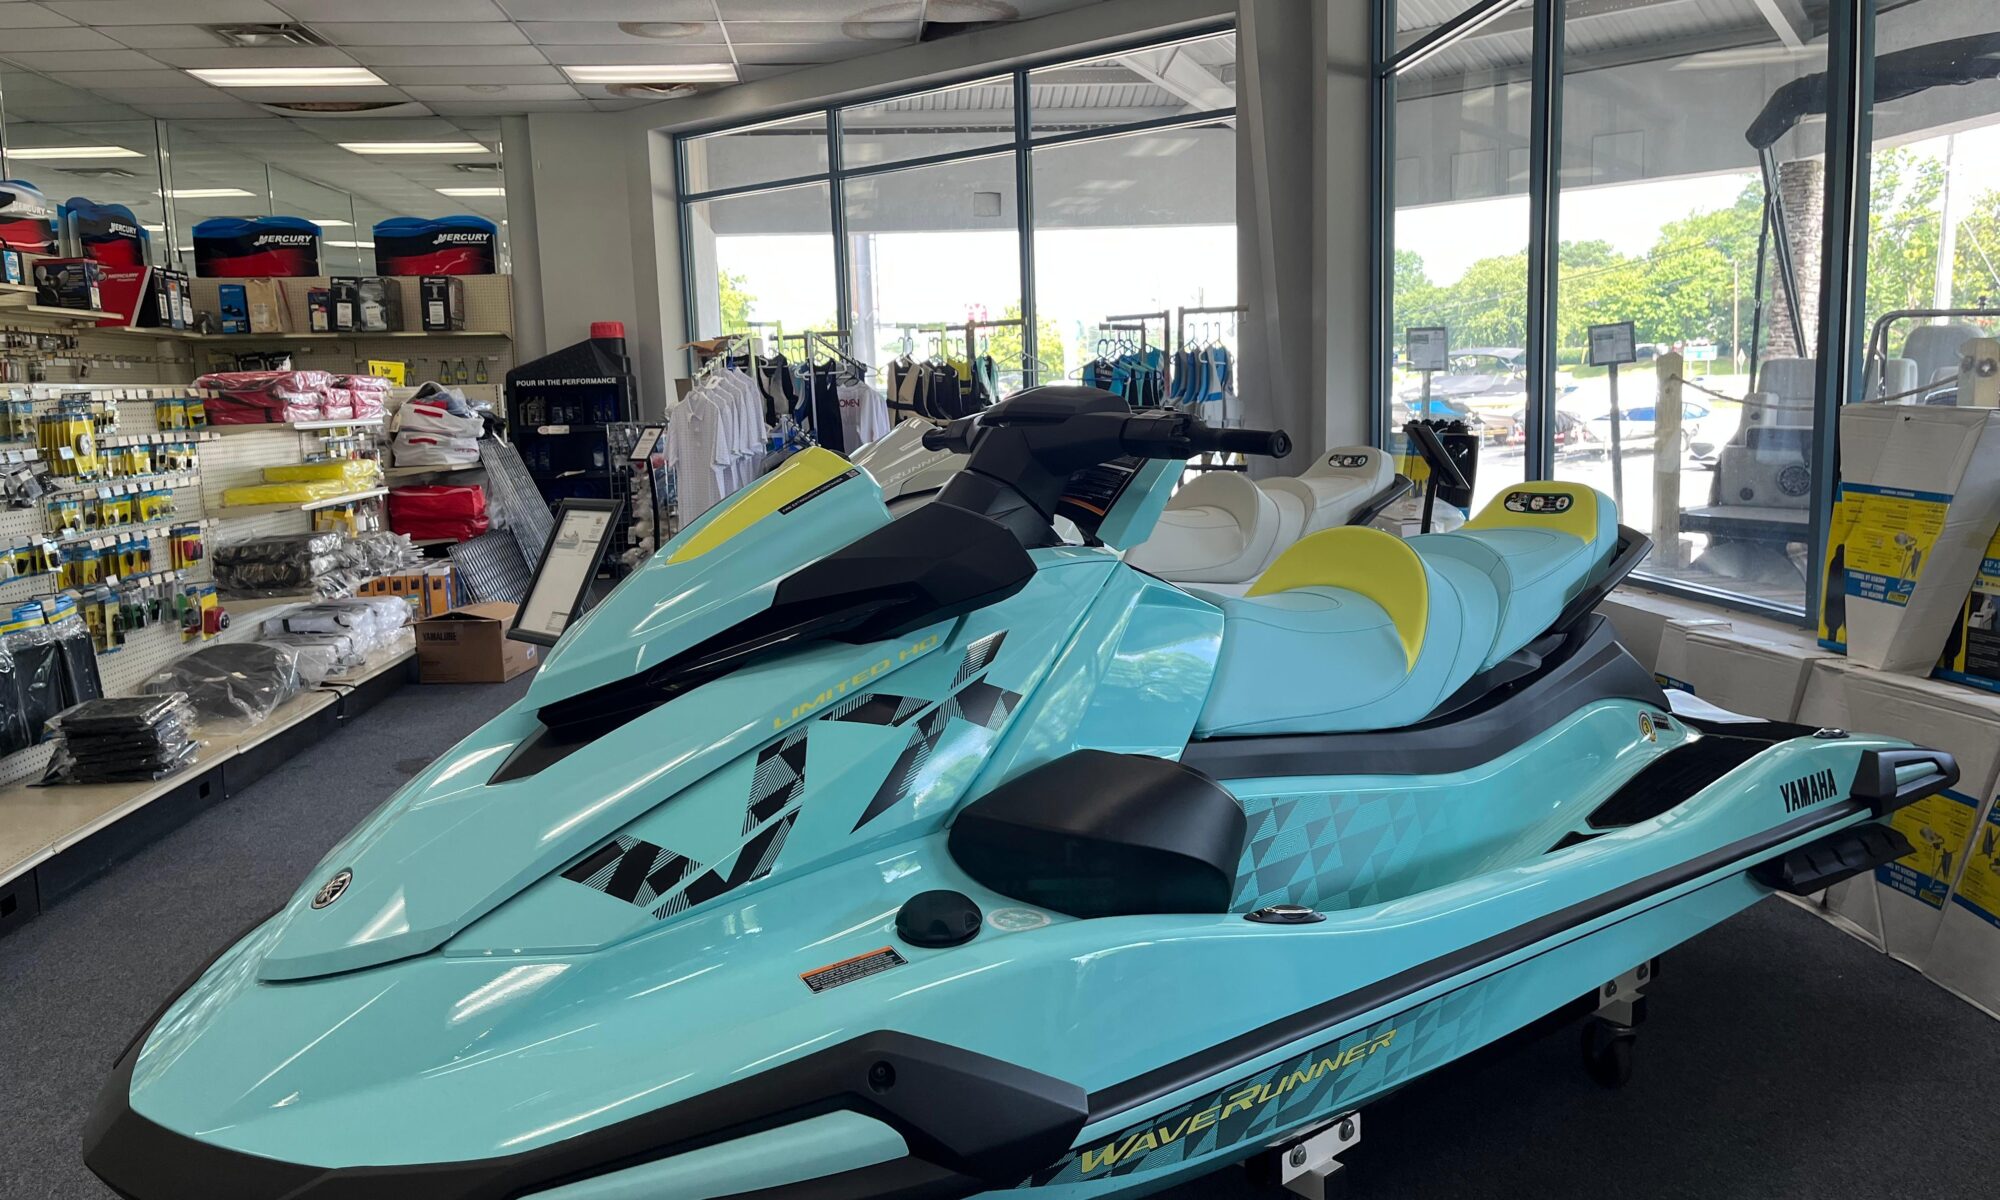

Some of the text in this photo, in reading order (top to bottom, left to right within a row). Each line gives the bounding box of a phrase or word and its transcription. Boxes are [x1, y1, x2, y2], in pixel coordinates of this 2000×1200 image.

[11, 201, 45, 215] MERCURY
[109, 222, 137, 235] MERCURY
[253, 235, 312, 246] MERCURY
[432, 233, 490, 245] MERCURY
[562, 377, 617, 386] PERFORMANCE
[839, 399, 860, 408] OMEN
[423, 632, 457, 640] YAMALUBE
[773, 659, 891, 729] LIMITED
[1780, 768, 1838, 814] YAMAHA
